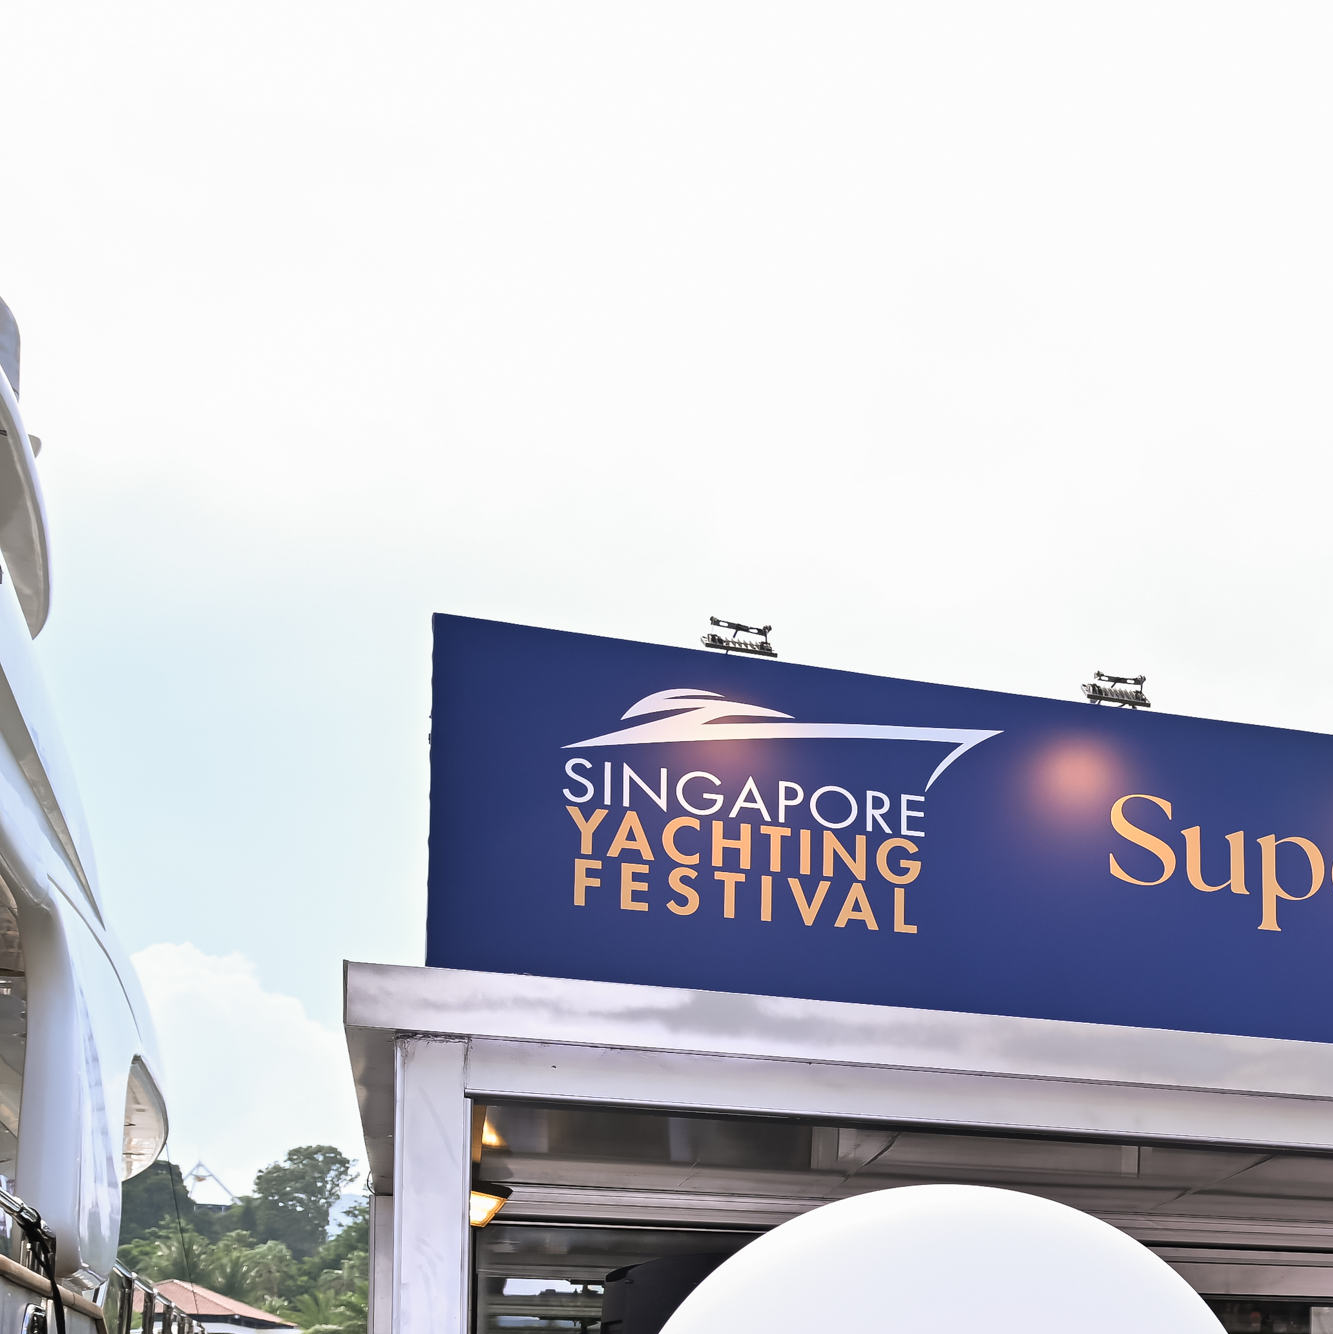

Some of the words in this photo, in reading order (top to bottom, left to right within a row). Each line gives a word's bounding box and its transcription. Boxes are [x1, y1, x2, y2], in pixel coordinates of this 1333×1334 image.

[562, 757, 925, 837] SINGAPORE
[565, 805, 921, 885] YACHTING
[573, 858, 917, 934] FESTIVAL
